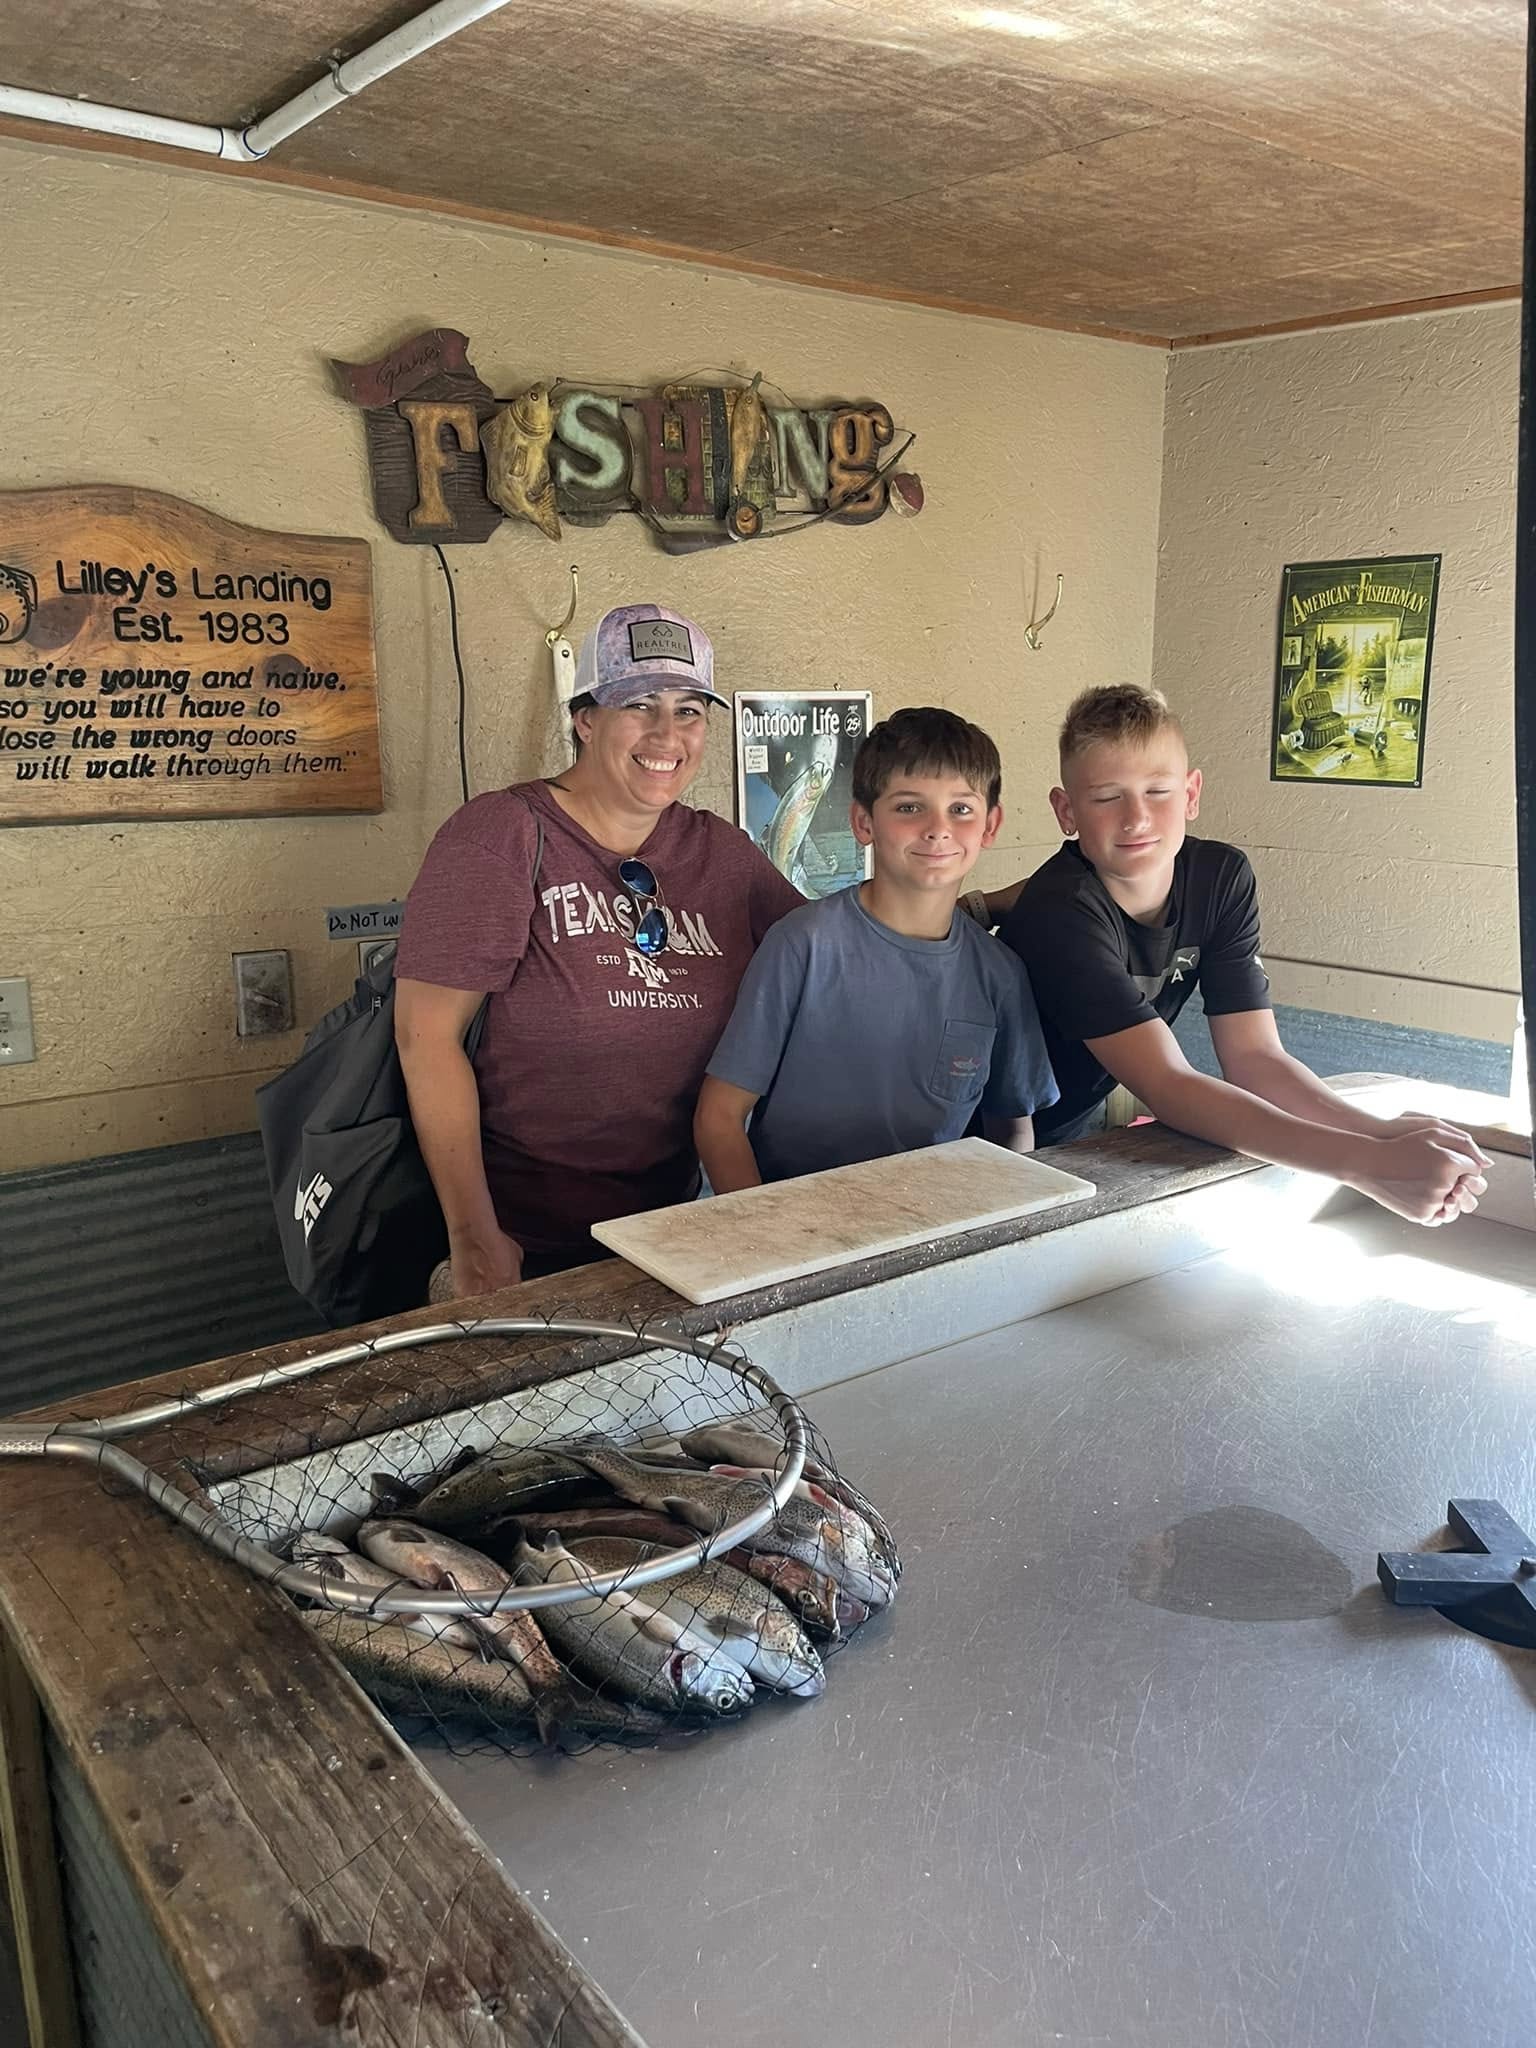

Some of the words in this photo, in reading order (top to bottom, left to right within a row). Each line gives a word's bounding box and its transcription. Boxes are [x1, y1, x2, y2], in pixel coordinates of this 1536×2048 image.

[56, 560, 177, 603] Lilley's
[192, 567, 331, 610] Landing
[1292, 584, 1351, 627] AMERICAN
[1357, 572, 1427, 613] FISHERMAN
[113, 607, 183, 642] Est.
[199, 611, 290, 645] 1983
[637, 640, 687, 651] REALTREE
[4, 662, 87, 688] we're
[100, 668, 191, 695] young
[202, 666, 253, 689] and
[0, 700, 29, 719] so
[43, 699, 97, 725] you
[110, 694, 167, 718] will
[178, 695, 245, 718] have
[257, 697, 281, 717] to
[742, 706, 807, 738] Outdoor
[812, 706, 840, 736] Life
[72, 725, 117, 749] the
[130, 728, 214, 753] wrong
[227, 725, 297, 746] doors
[16, 755, 71, 780] will
[86, 753, 156, 778] walk
[166, 752, 271, 780] through
[329, 915, 347, 932] Do
[350, 911, 379, 931] NOT
[383, 914, 405, 928] UN
[541, 881, 637, 945] TEXAS
[596, 955, 621, 965] ESTD
